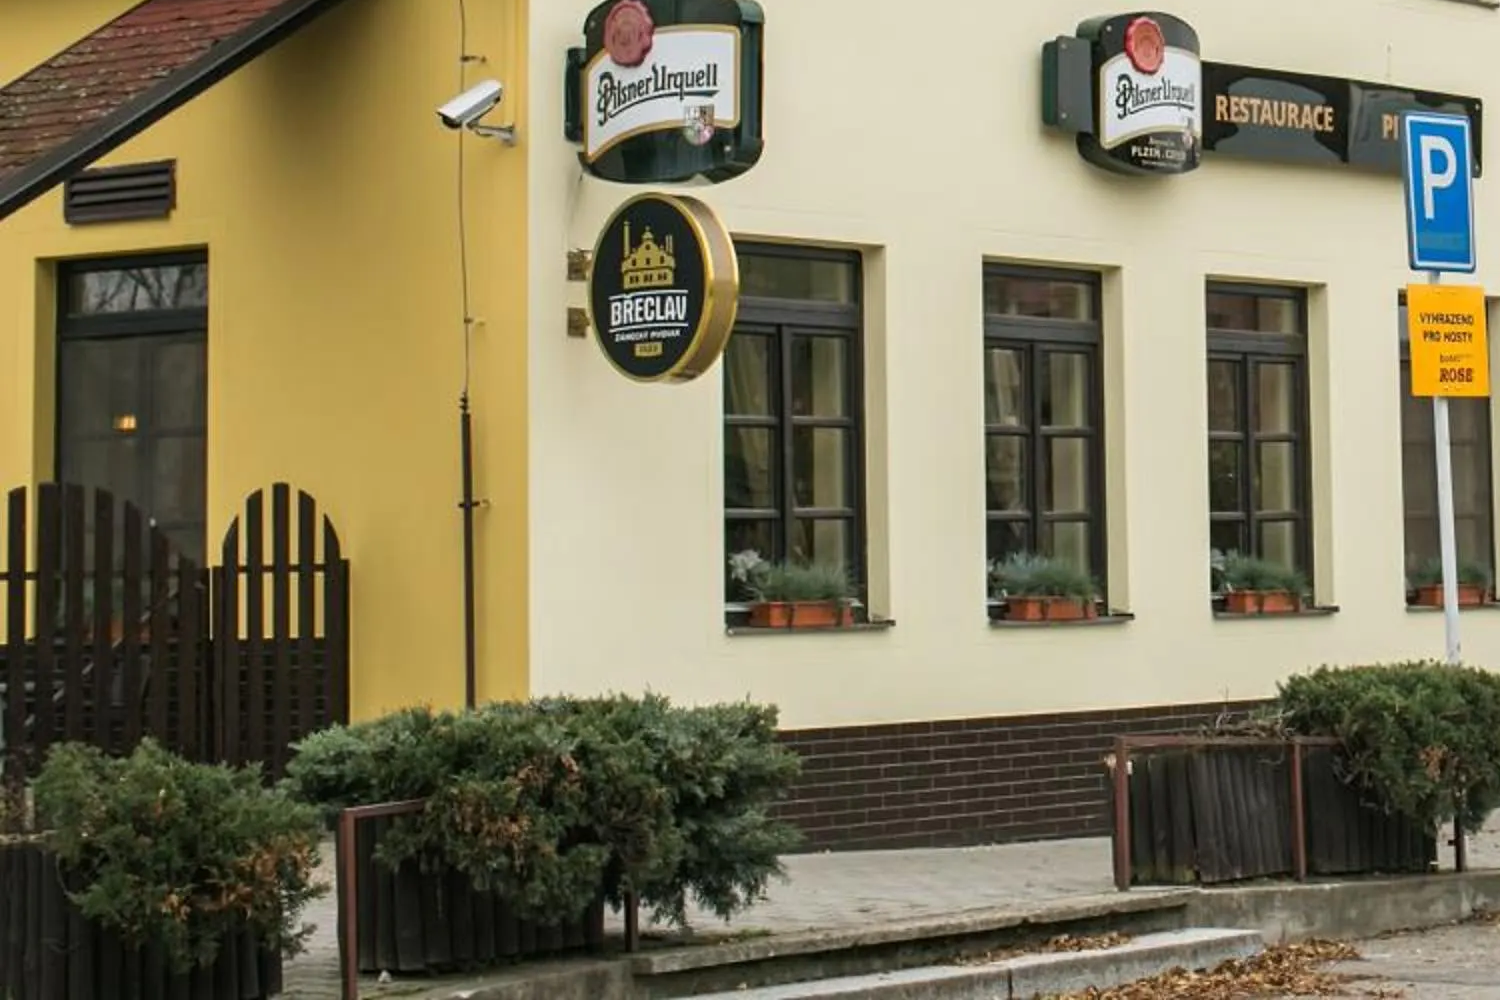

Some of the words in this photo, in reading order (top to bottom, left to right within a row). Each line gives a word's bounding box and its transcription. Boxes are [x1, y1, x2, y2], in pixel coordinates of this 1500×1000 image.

[597, 71, 652, 126] Pilsner
[652, 62, 718, 101] Urquell
[1215, 94, 1334, 131] RESTAURACE
[1420, 135, 1457, 219] P
